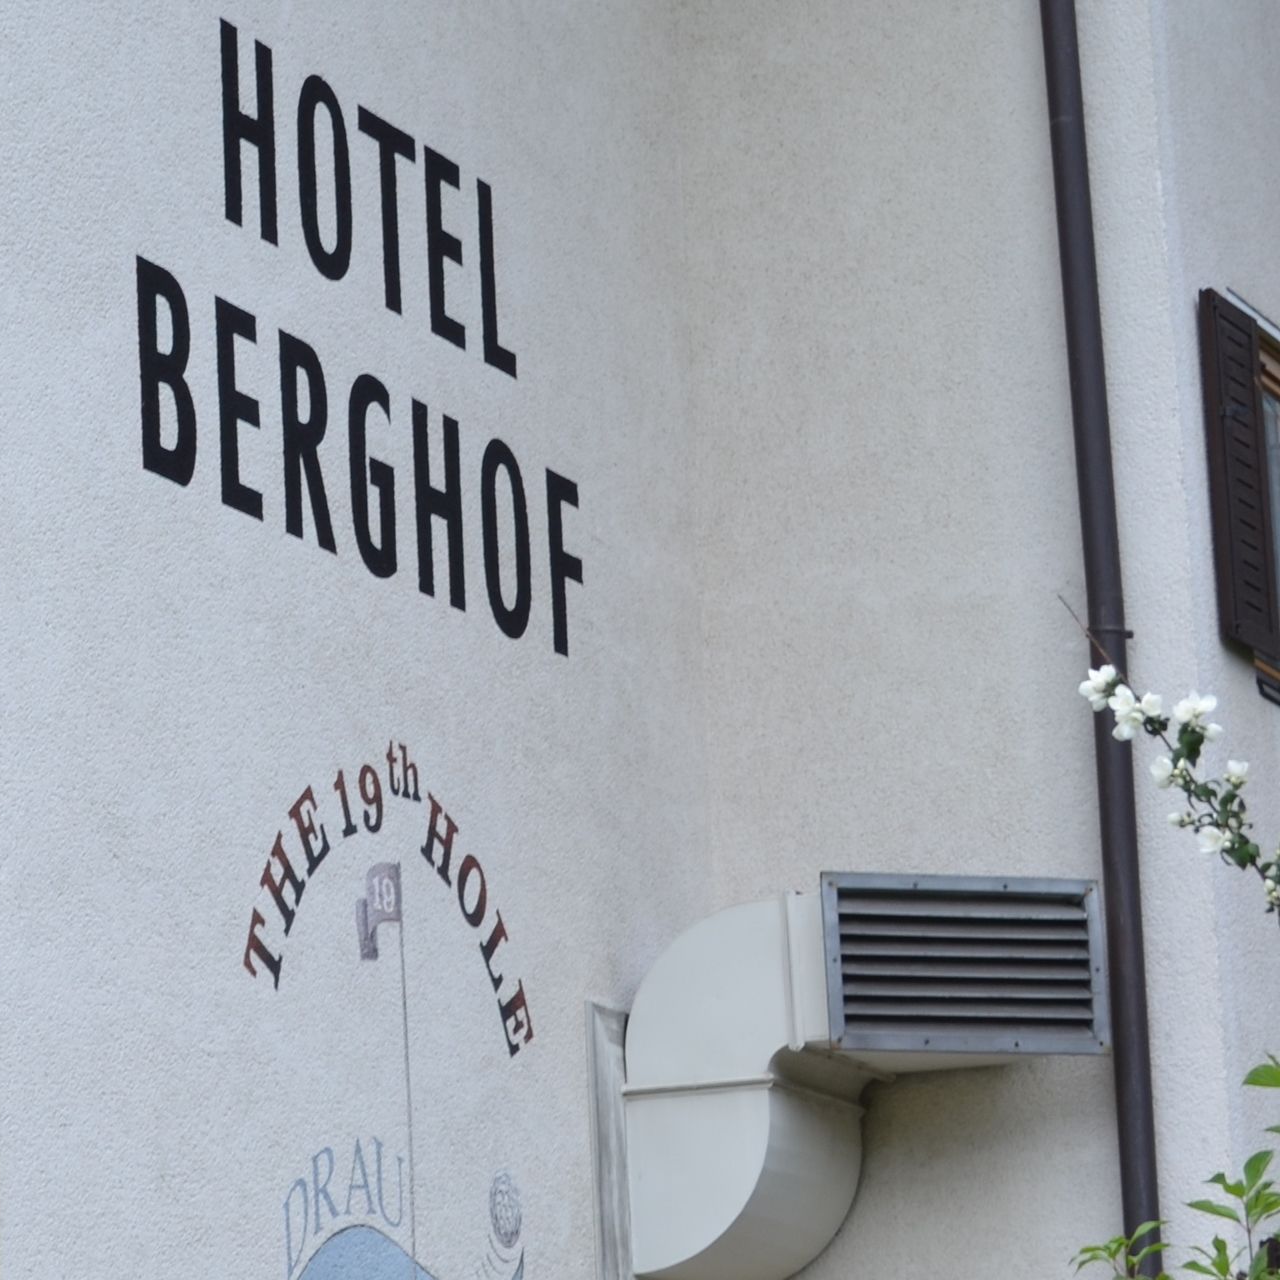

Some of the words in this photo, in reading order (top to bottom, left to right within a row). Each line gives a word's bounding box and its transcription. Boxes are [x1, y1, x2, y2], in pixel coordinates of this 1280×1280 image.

[220, 16, 518, 380] HOTEL
[135, 253, 584, 658] BERGHOF
[243, 784, 331, 992] THE
[333, 739, 422, 839] 19th
[420, 791, 534, 1058] HOLE
